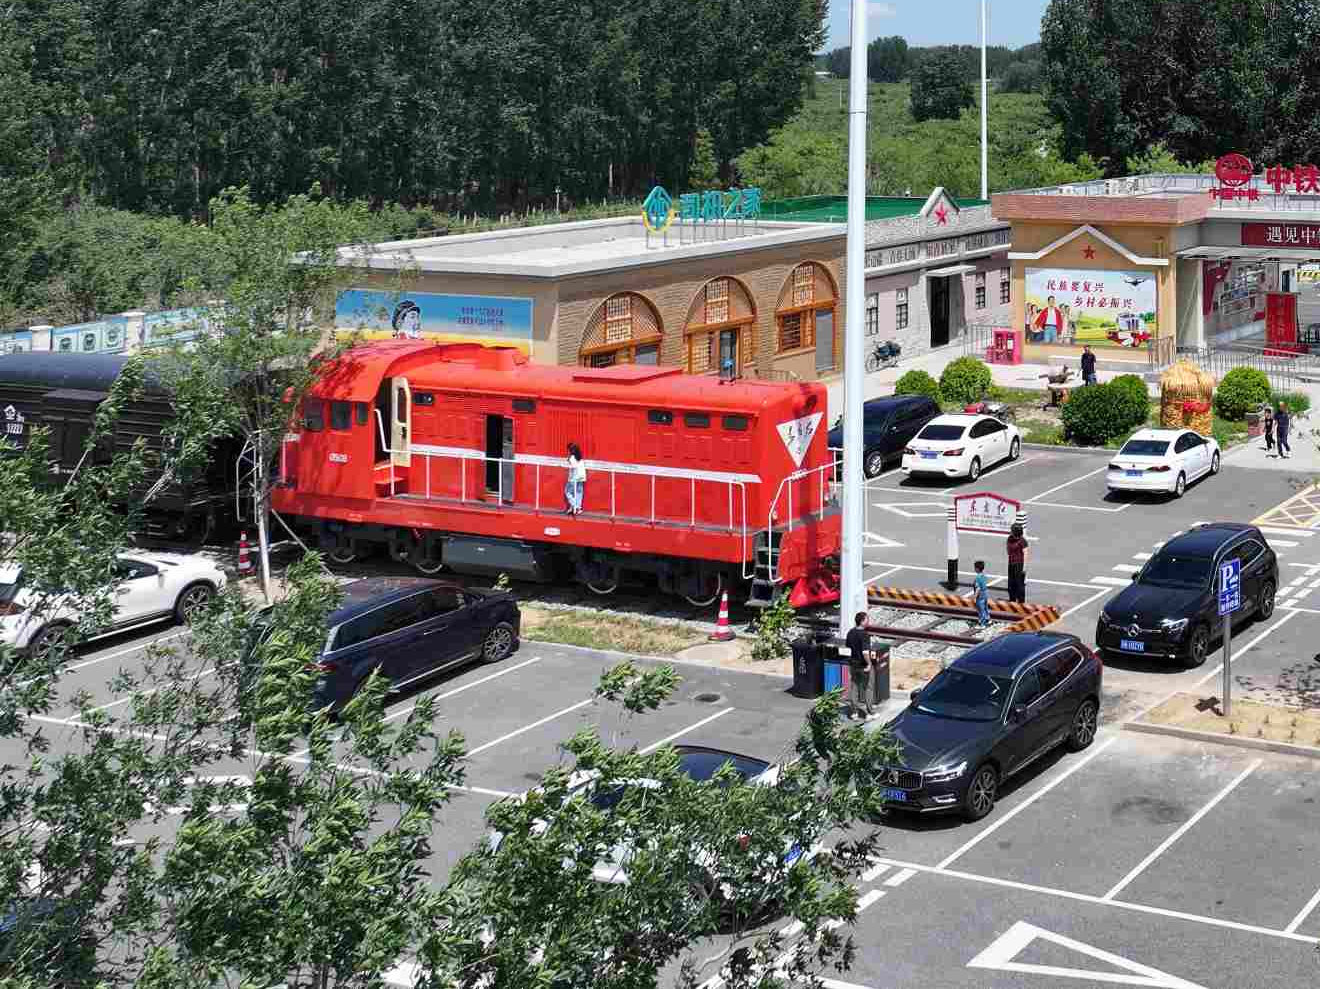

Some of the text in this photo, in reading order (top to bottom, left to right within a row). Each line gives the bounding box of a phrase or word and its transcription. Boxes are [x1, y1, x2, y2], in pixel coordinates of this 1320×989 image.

[1047, 279, 1104, 292] 民族要复兴
[1222, 564, 1234, 592] P
